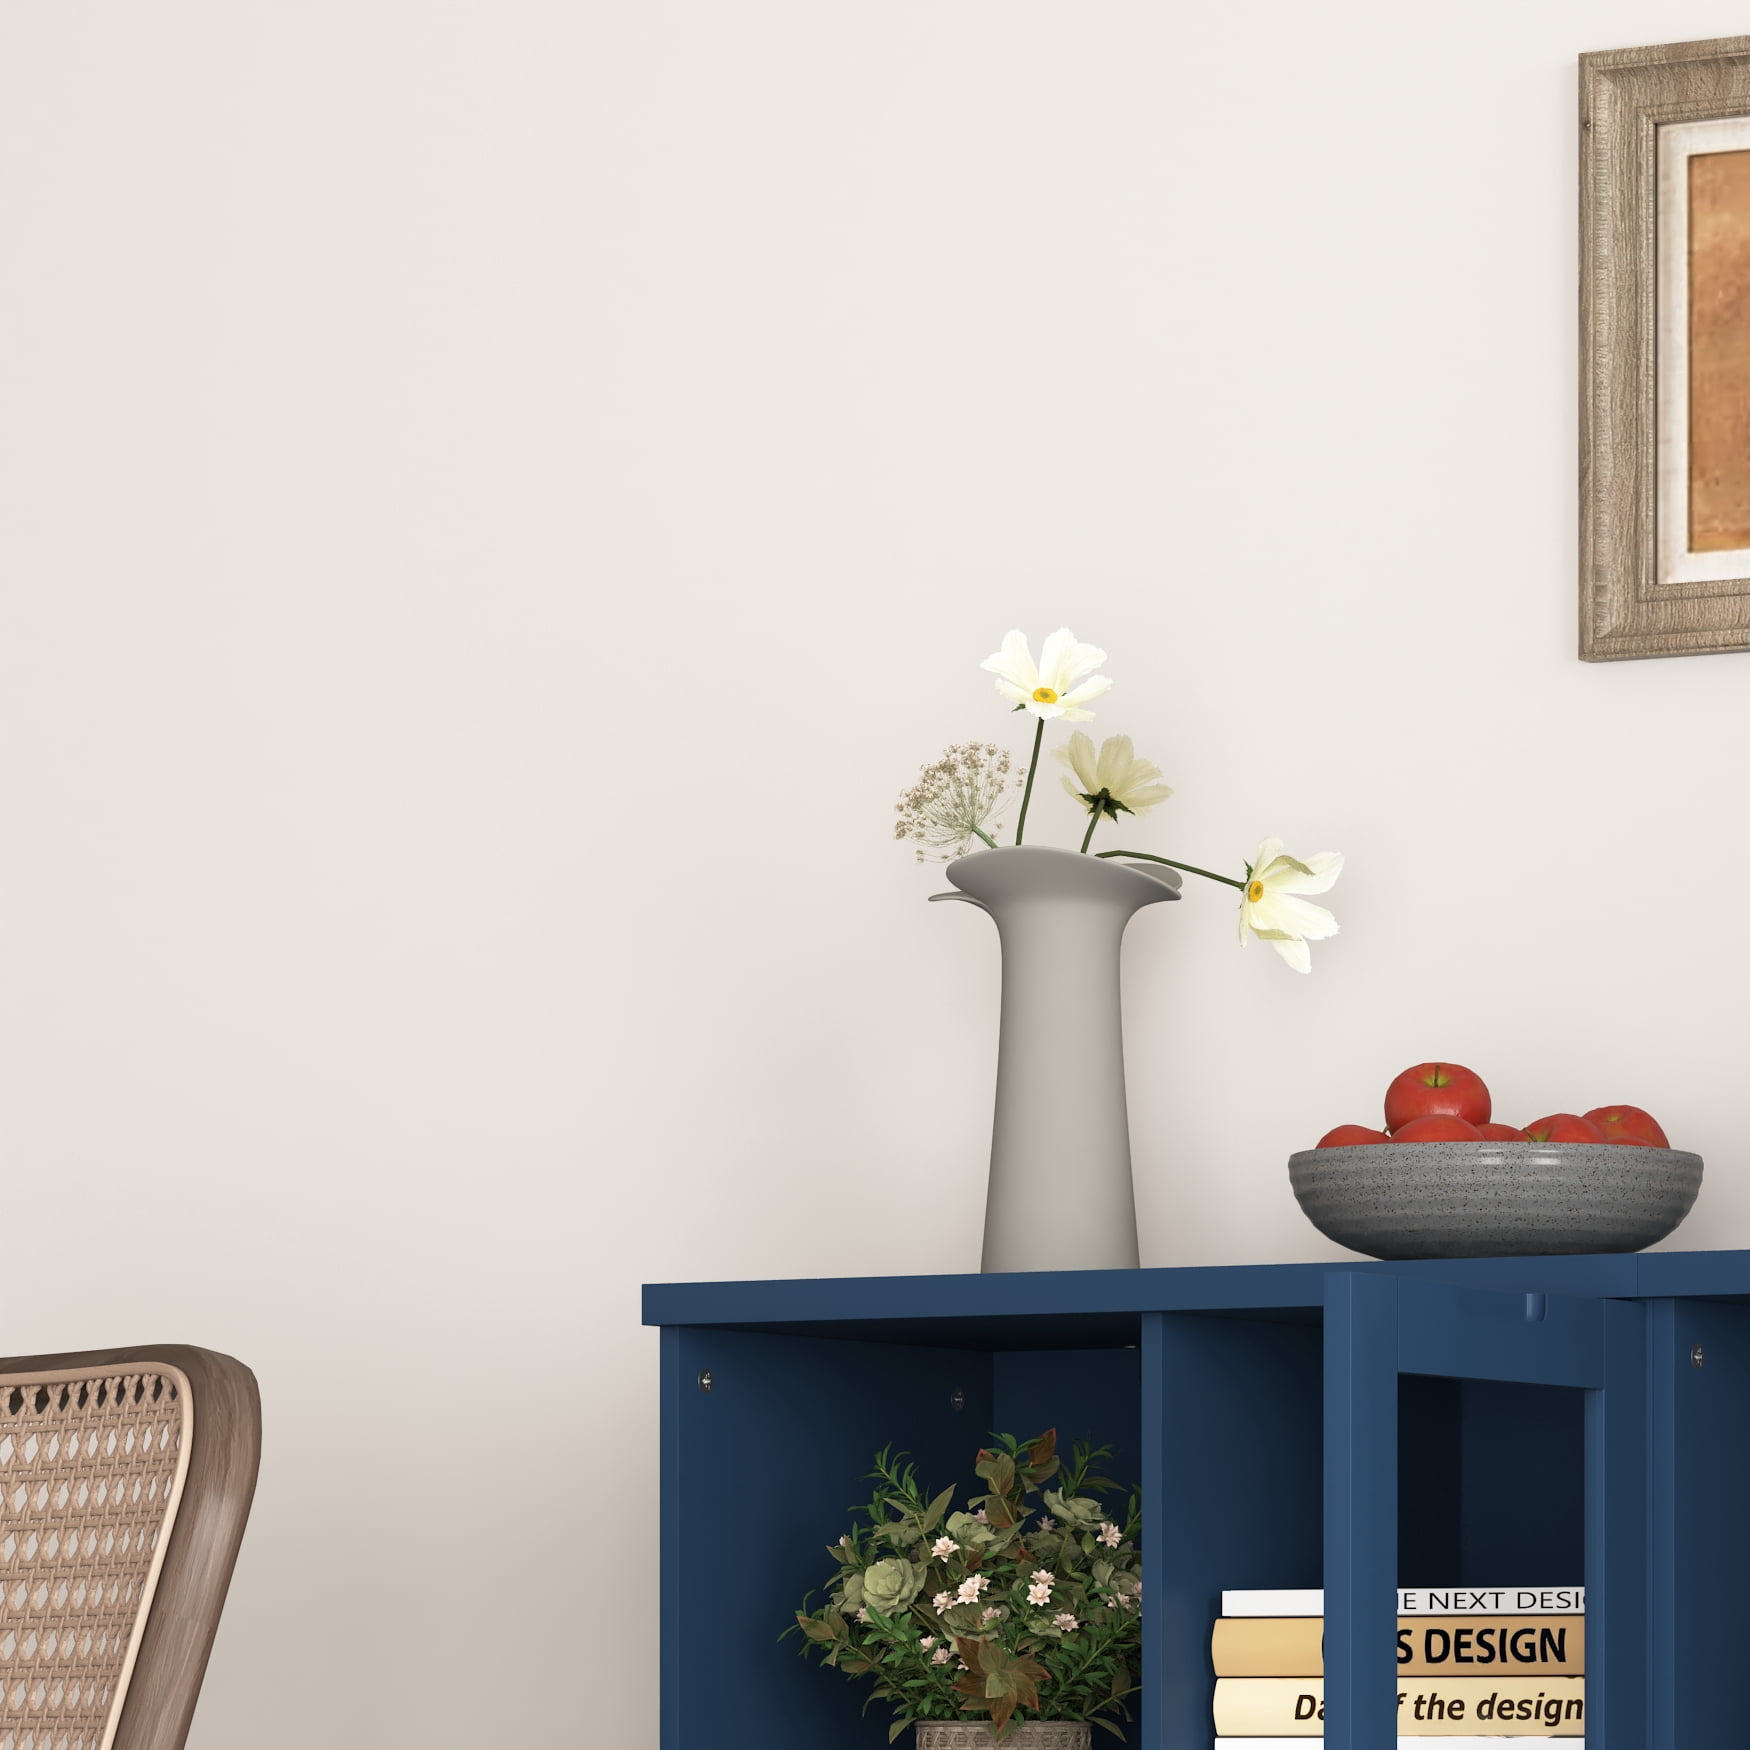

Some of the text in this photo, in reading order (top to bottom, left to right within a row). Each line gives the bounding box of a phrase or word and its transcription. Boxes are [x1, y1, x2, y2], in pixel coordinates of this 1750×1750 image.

[1429, 1592, 1505, 1609] NEXT
[1517, 1591, 1585, 1609] DESI
[1425, 1628, 1566, 1664] DESIGN
[1414, 1693, 1465, 1720] the
[1477, 1692, 1584, 1726] design
